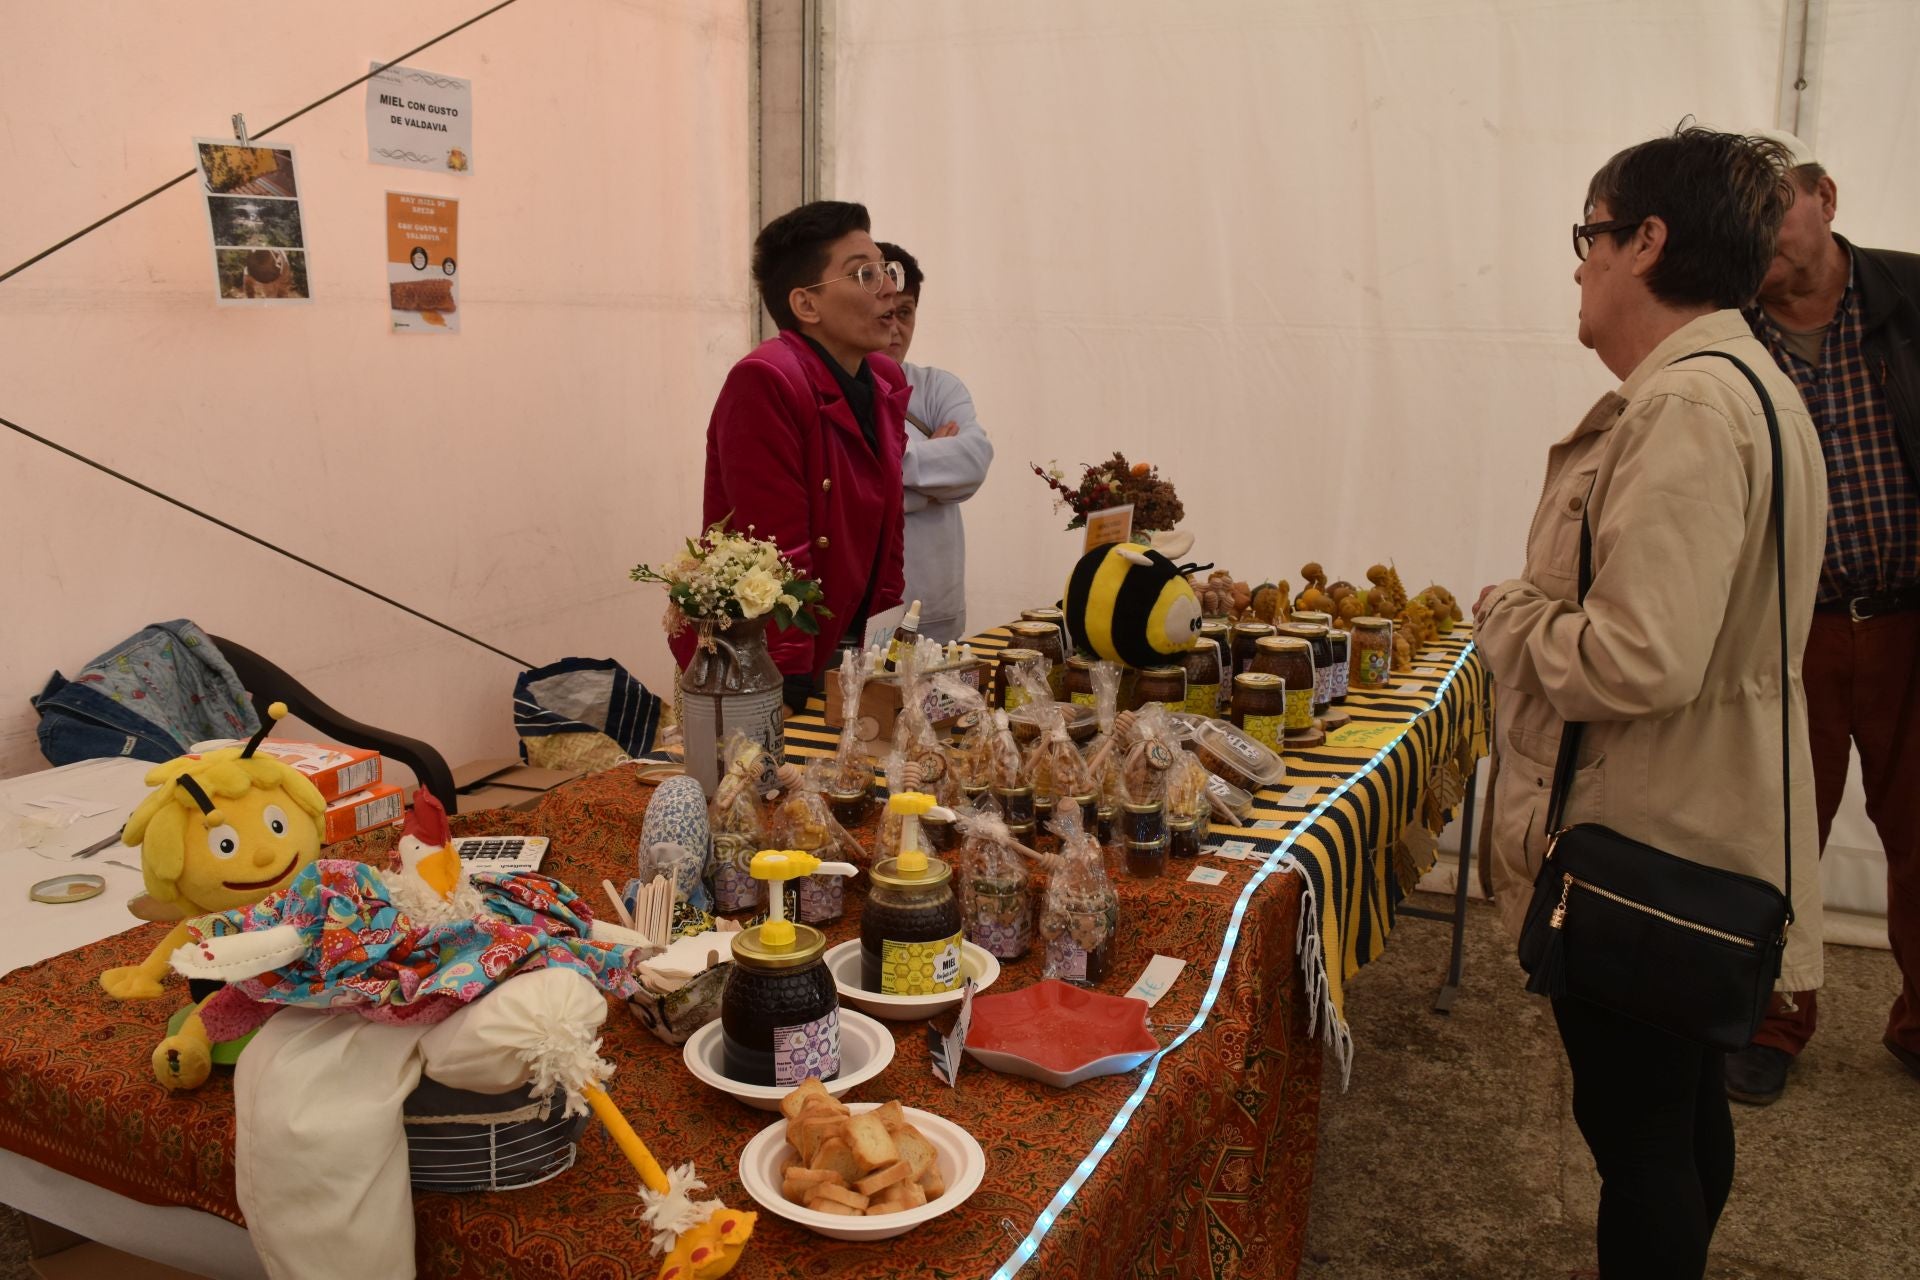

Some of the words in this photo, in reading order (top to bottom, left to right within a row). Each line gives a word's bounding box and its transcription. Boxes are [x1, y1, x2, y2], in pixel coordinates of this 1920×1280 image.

[380, 94, 405, 108] MIEL
[407, 101, 426, 112] CON
[428, 105, 458, 117] GUSTO
[390, 115, 403, 125] DE
[404, 118, 448, 132] VALDAVIA
[943, 958, 956, 970] MIEL
